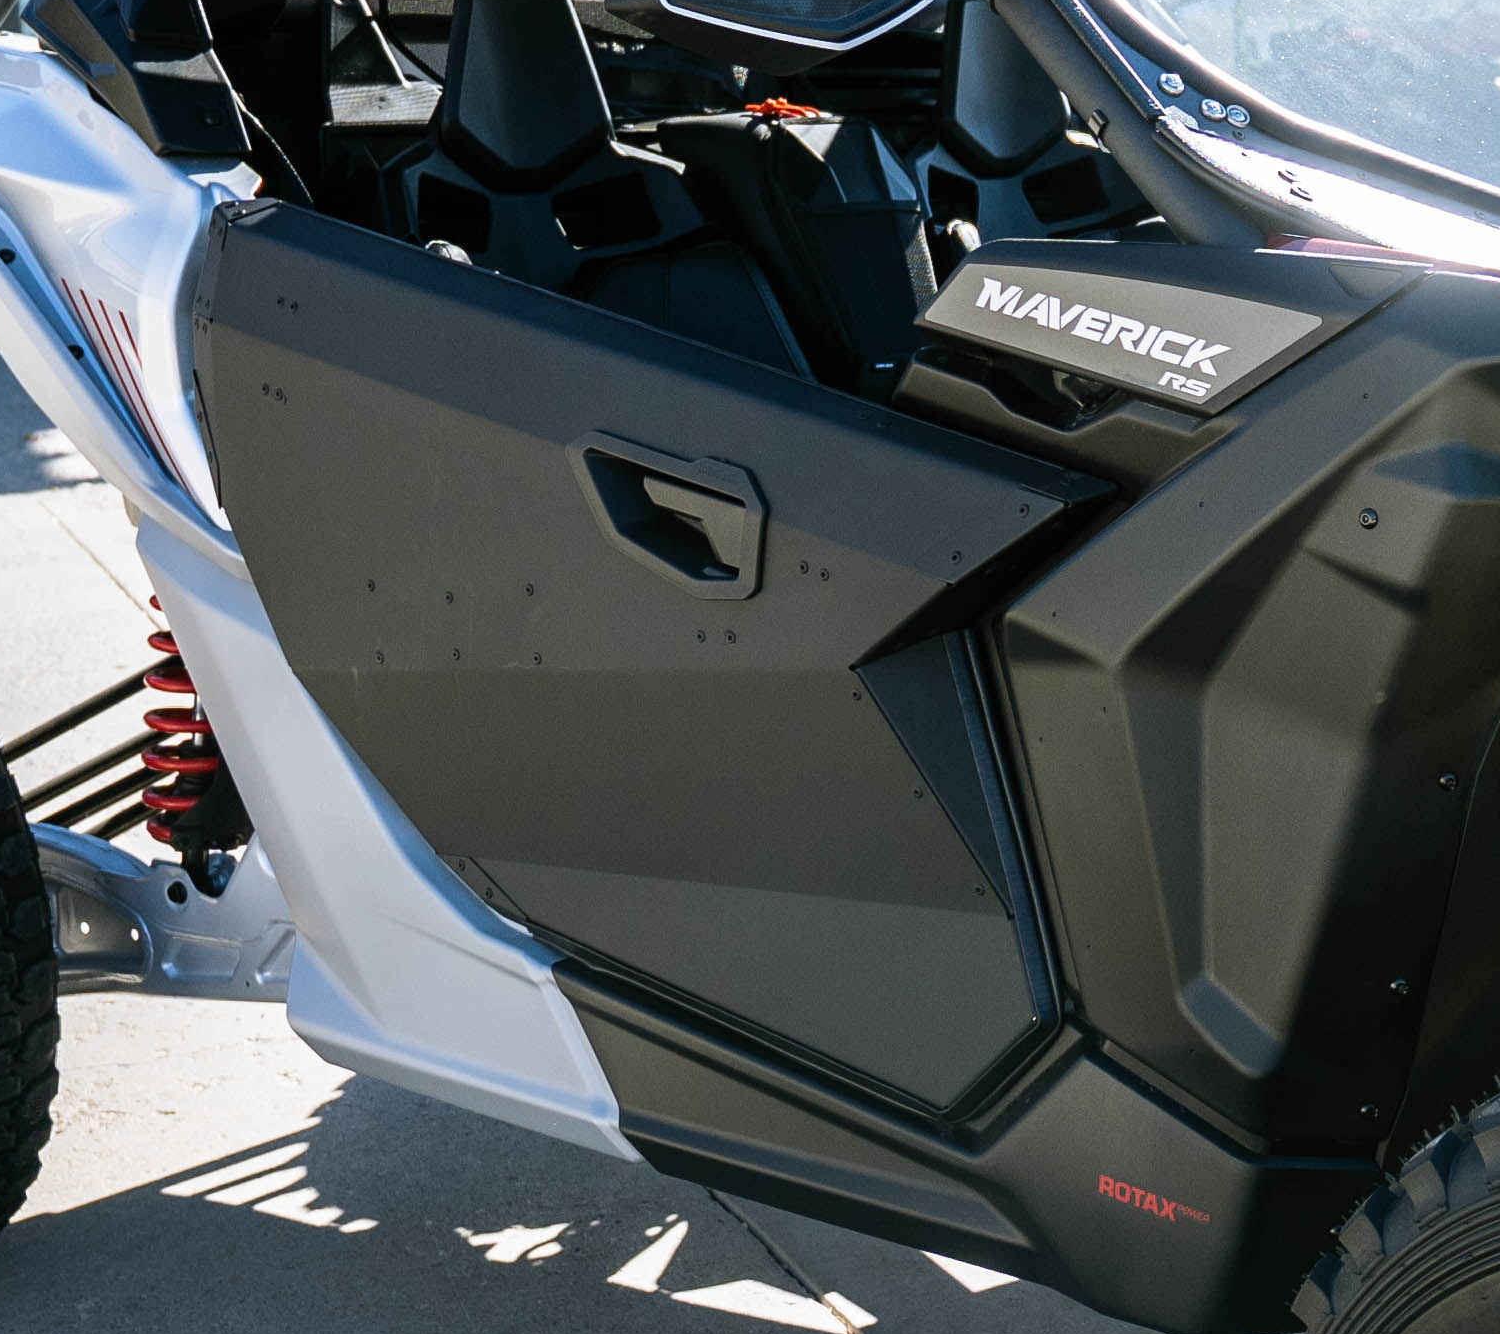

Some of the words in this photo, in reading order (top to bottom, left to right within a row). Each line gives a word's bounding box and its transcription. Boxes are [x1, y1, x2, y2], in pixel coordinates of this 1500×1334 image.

[975, 277, 1231, 377] MAVERICK
[1158, 371, 1212, 397] RS
[1099, 1175, 1177, 1221] ROTAX
[1178, 1204, 1210, 1222] POWER
